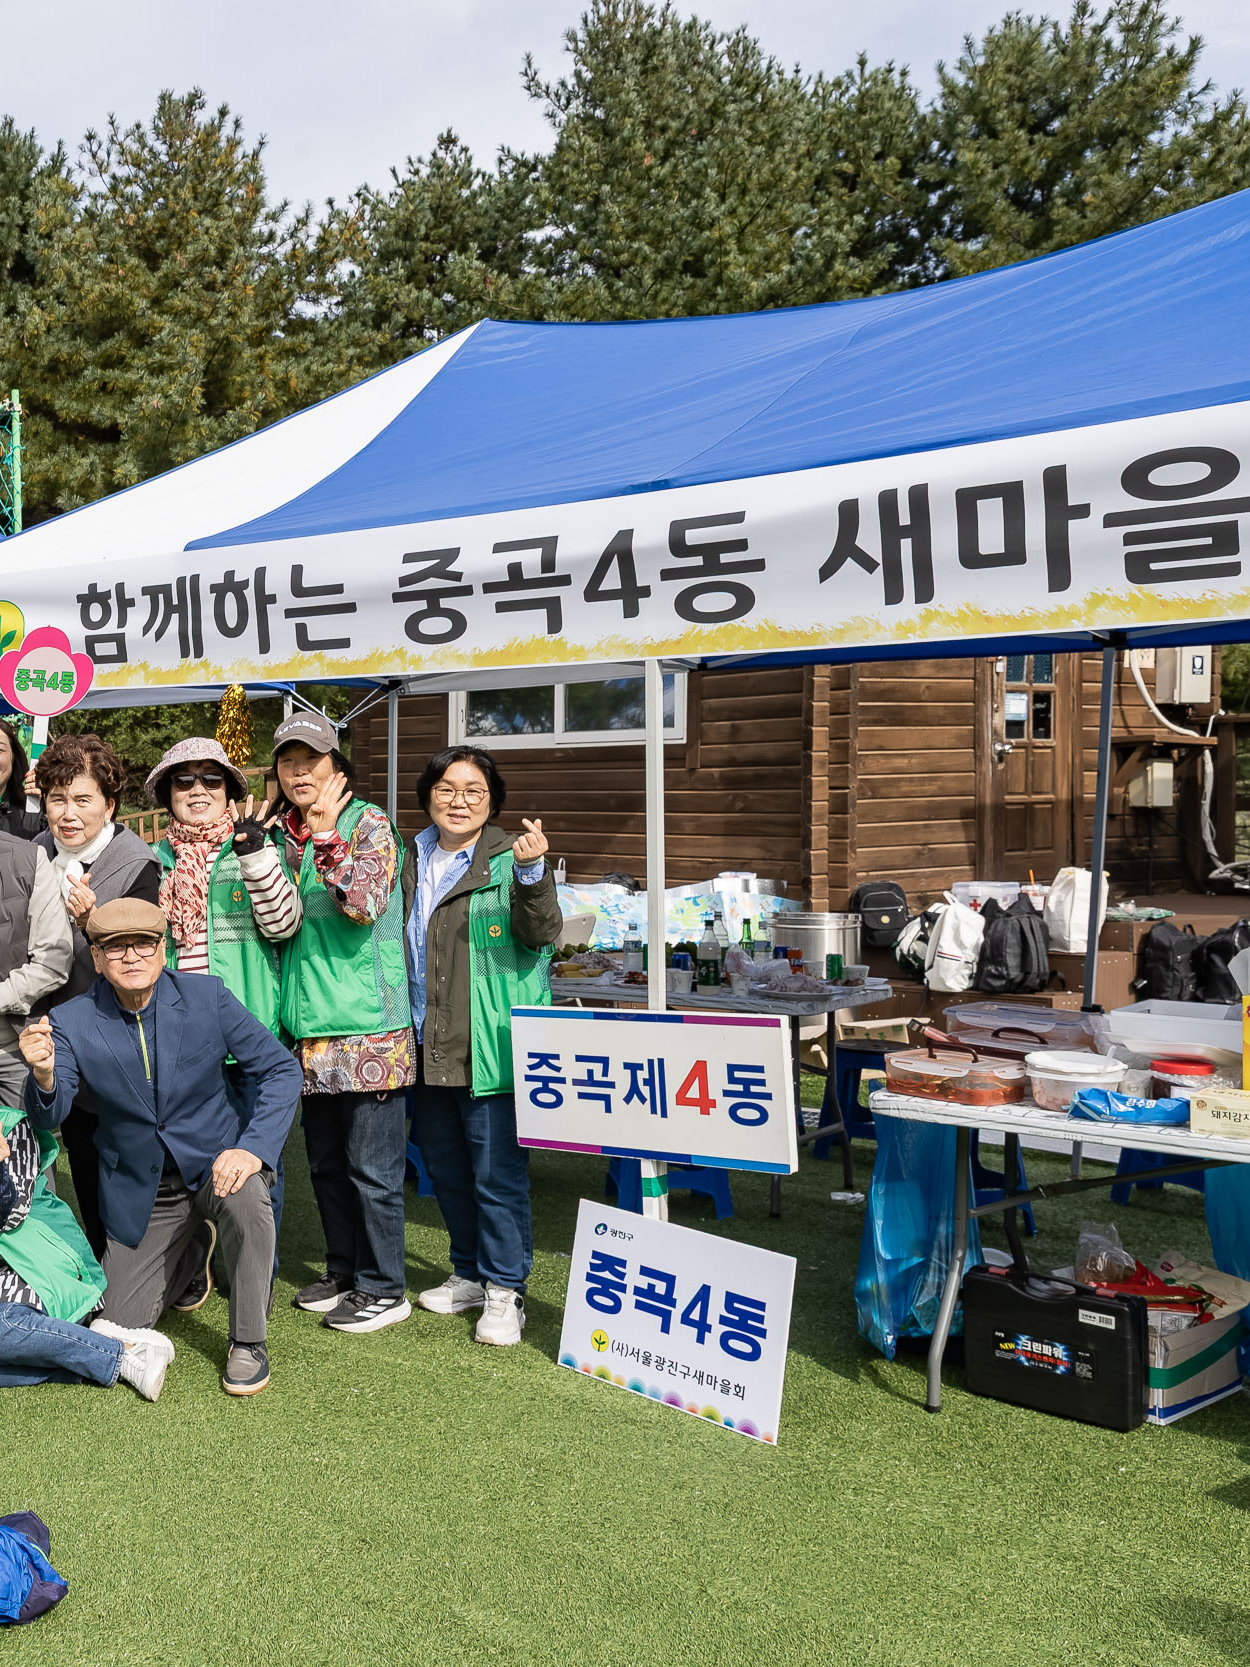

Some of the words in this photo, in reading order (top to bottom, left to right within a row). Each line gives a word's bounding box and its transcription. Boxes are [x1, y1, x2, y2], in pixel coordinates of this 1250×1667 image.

[76, 564, 357, 665] 함께하는
[392, 510, 766, 646] 중곡4동
[818, 445, 1250, 606] 새마을
[14, 668, 75, 694] 중곡4동
[524, 1051, 773, 1127] 중곡제4동
[610, 1228, 634, 1242] 광진구
[585, 1249, 768, 1362] 중곡4동
[999, 1342, 1016, 1350] NEW
[1021, 1339, 1064, 1360] 크린파워
[610, 1338, 746, 1401] (사)서울광진구새마을회
